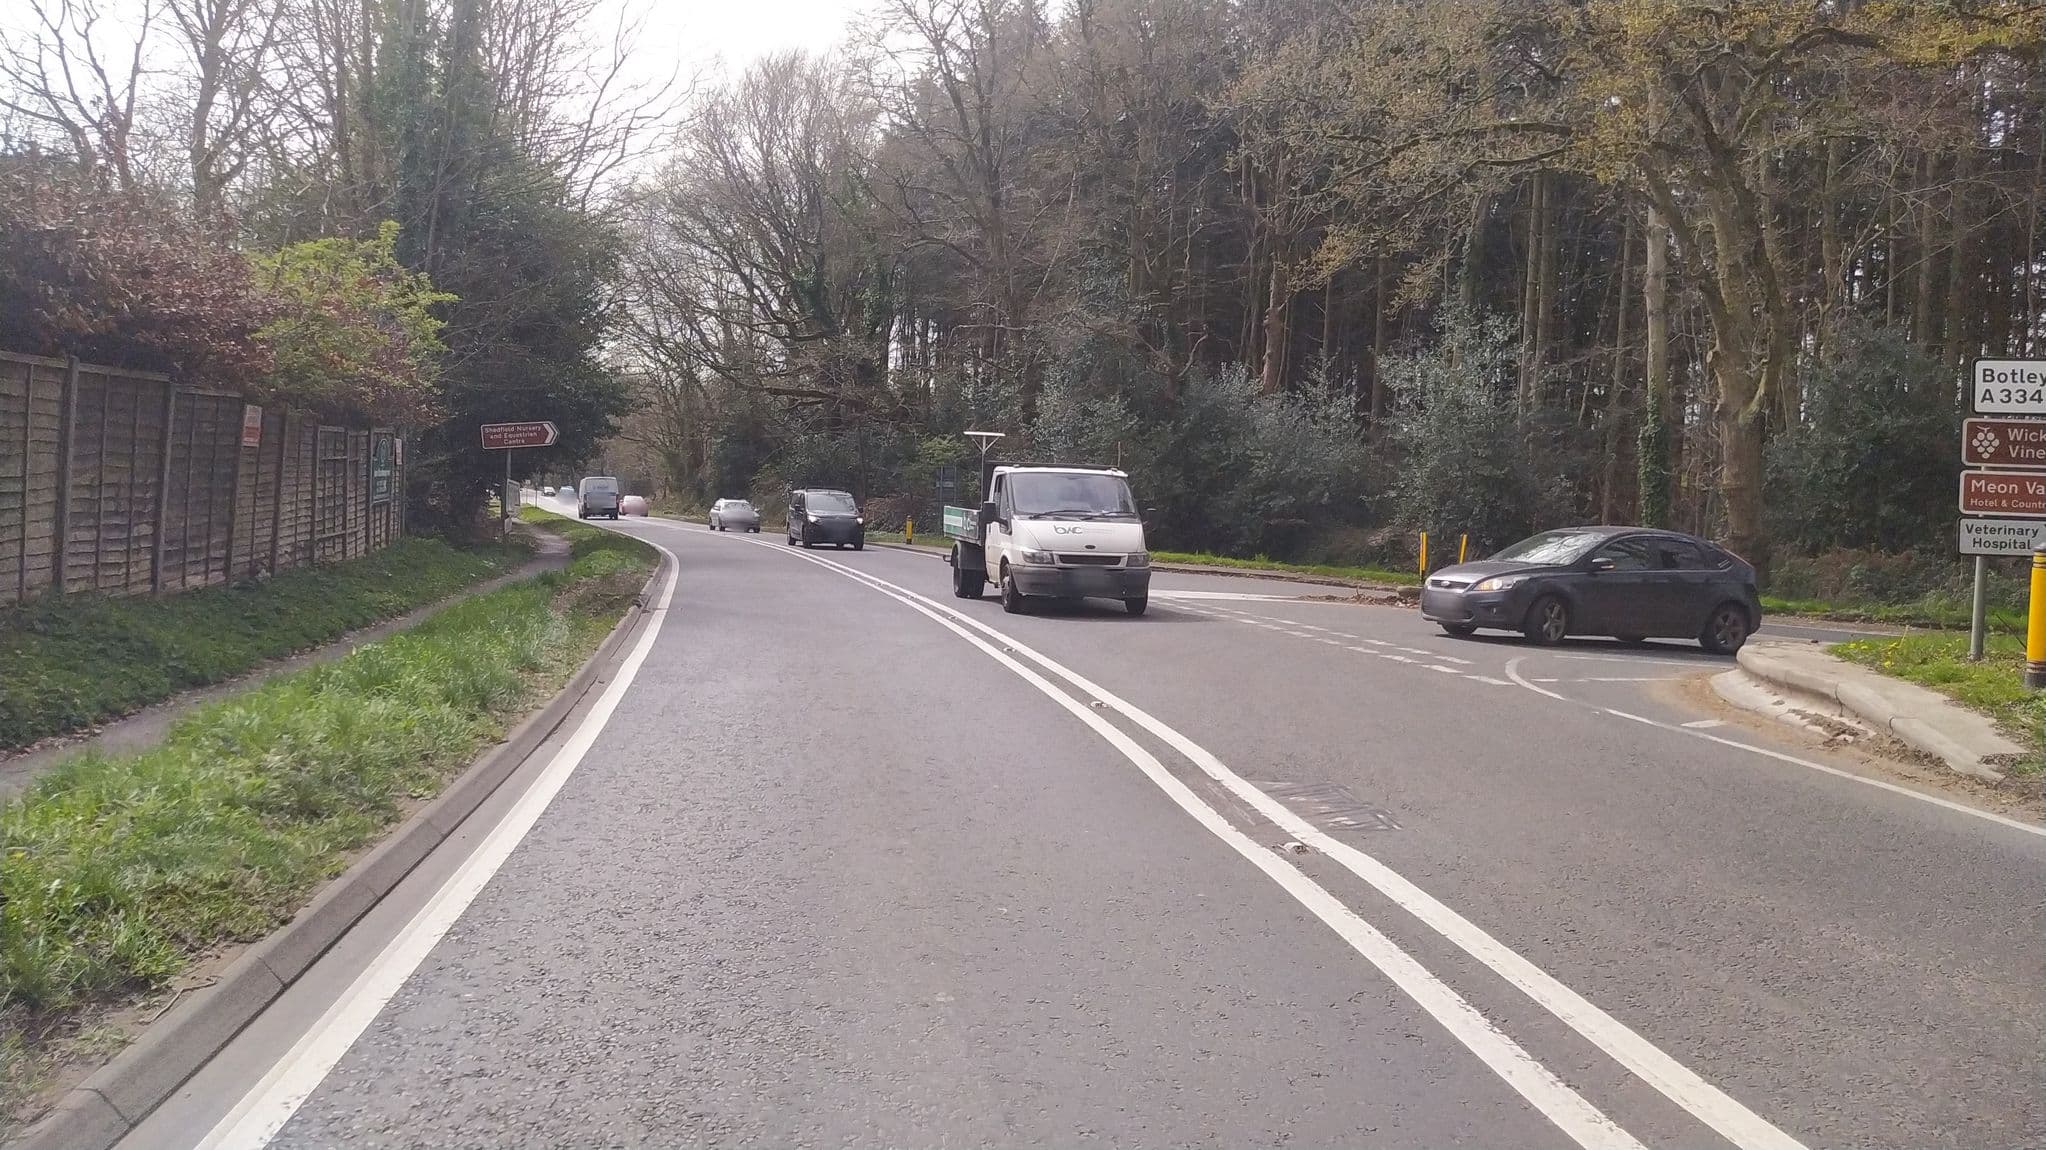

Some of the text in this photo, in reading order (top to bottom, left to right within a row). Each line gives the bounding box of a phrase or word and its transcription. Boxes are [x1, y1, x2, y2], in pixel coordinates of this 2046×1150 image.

[1982, 368, 2046, 387] Botley
[2008, 445, 2046, 460] Vine
[1971, 479, 2046, 495] Meon Va
[1970, 498, 1998, 507] Hotel
[1966, 524, 2039, 538] Veterinary
[1972, 537, 2031, 551] Hospital
